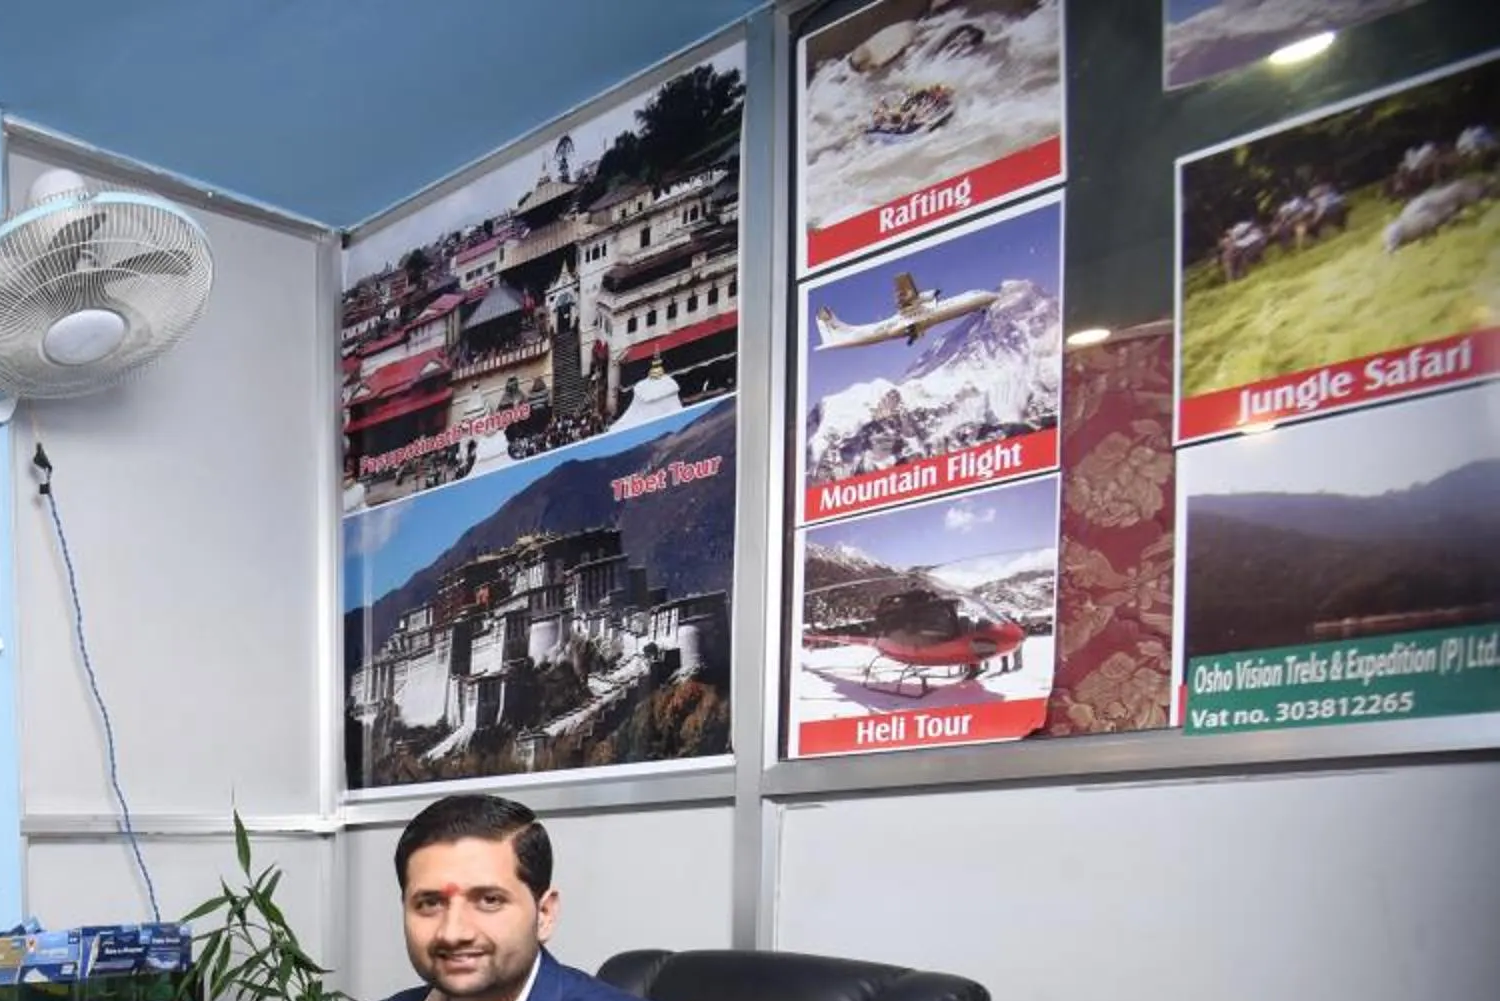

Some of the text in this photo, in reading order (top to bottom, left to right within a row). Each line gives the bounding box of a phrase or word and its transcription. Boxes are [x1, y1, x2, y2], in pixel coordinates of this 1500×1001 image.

[879, 177, 972, 233] Rafting
[1236, 338, 1473, 425] Jungle Safari
[466, 401, 531, 436] Temple
[611, 456, 723, 501] Tibet Tour
[819, 442, 1024, 511] Mountain Flight
[1193, 664, 1233, 695] Osho
[1234, 658, 1284, 692] Vision
[1284, 652, 1328, 686] Treks
[1329, 651, 1344, 681] &
[1345, 642, 1437, 686] Expedition
[1439, 637, 1465, 676] (P)
[856, 714, 973, 745] Heli Tour
[1190, 691, 1415, 730] Vat no. 303812265
